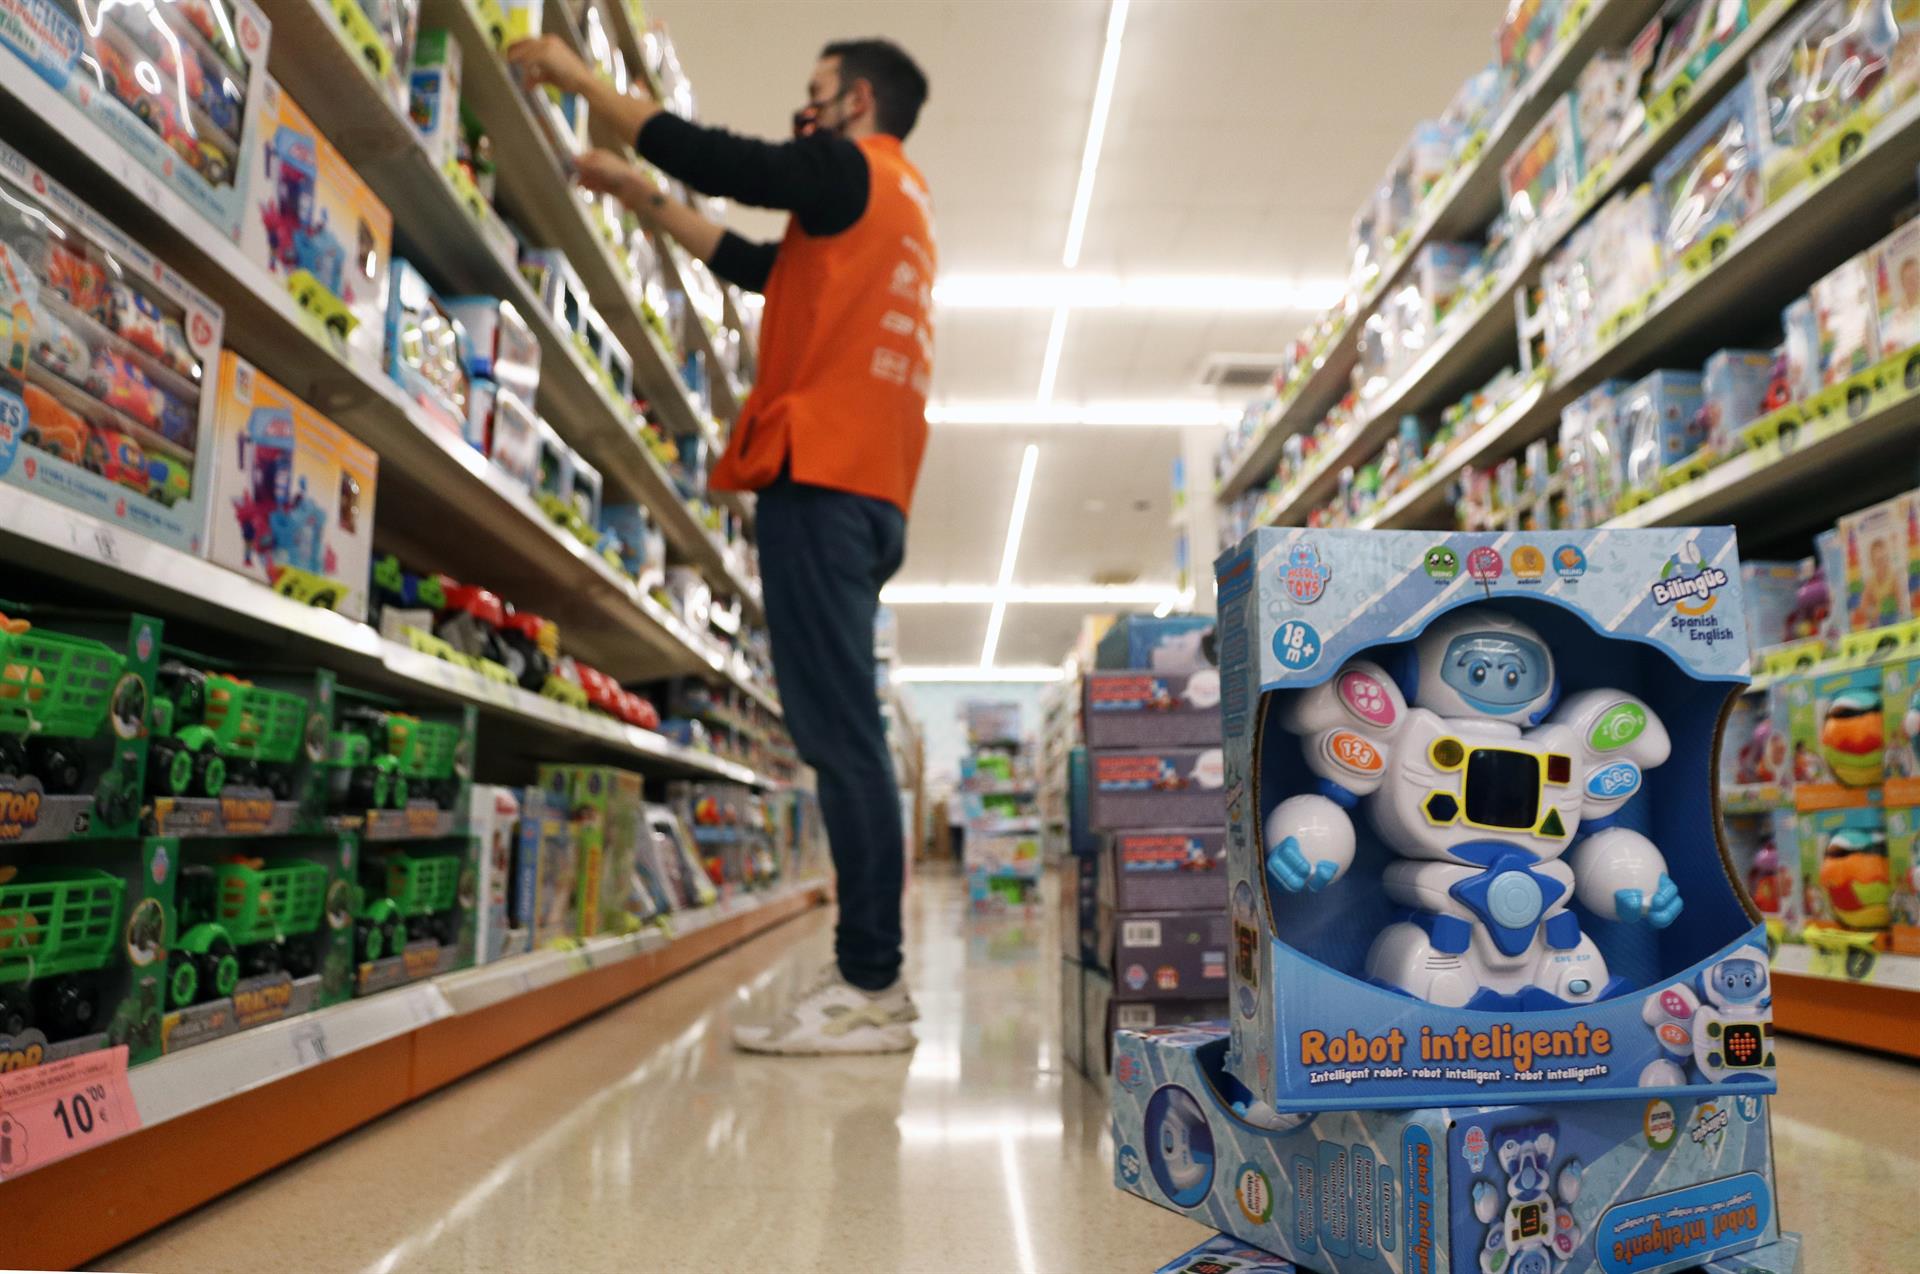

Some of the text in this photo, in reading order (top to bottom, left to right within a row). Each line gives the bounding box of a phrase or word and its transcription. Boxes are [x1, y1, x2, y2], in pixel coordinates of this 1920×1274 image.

[1287, 579, 1320, 597] TOYS
[1652, 568, 1727, 605] Bilingüe
[1671, 614, 1718, 632] Spanish
[1689, 628, 1734, 646] English
[1301, 1022, 1611, 1073] Robot inteligente
[1310, 1067, 1370, 1084] Intelligent
[1412, 1068, 1441, 1079] robot
[1445, 1067, 1501, 1085] intelligent
[1514, 1070, 1543, 1081] robot
[1547, 1064, 1608, 1083] intelligente
[54, 1093, 94, 1140] 10
[1416, 1143, 1430, 1196] Robot
[1364, 1159, 1374, 1249] Reading graphics
[1383, 1182, 1391, 1201] LED
[1612, 1203, 1758, 1265] Robot inteligente
